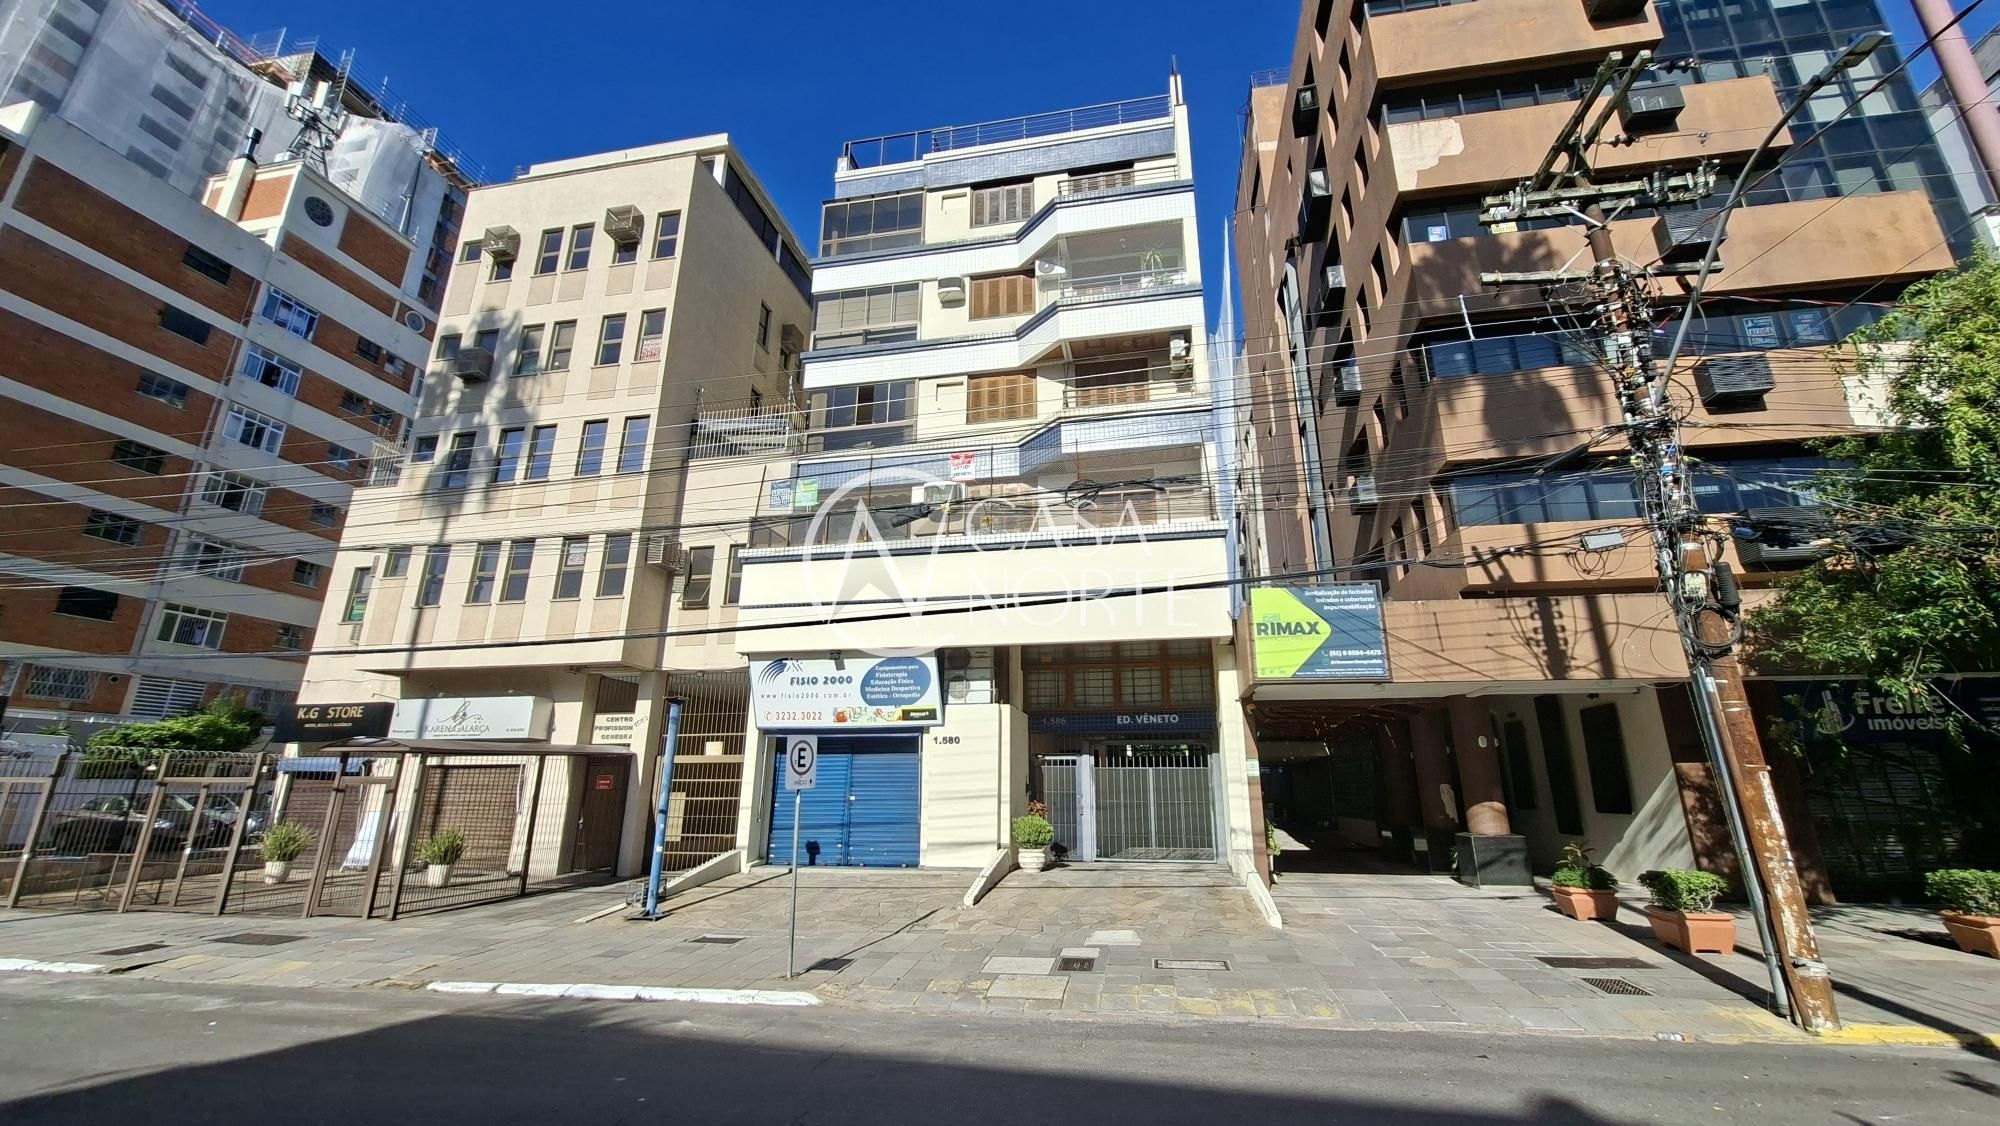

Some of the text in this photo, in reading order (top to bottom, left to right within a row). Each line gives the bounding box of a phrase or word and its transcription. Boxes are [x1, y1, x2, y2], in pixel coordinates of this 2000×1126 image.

[1256, 621, 1321, 635] RIMAX
[790, 675, 853, 686] FISIO 2000
[297, 706, 365, 719] K.G STORE
[775, 711, 823, 720] 3232.3022
[1117, 712, 1179, 724] ED. VÊNETO
[1041, 717, 1067, 725] 1.586
[423, 724, 452, 733] KAREN
[453, 724, 490, 734] GALARÇA
[933, 736, 961, 744] 1.580
[797, 747, 807, 767] E
